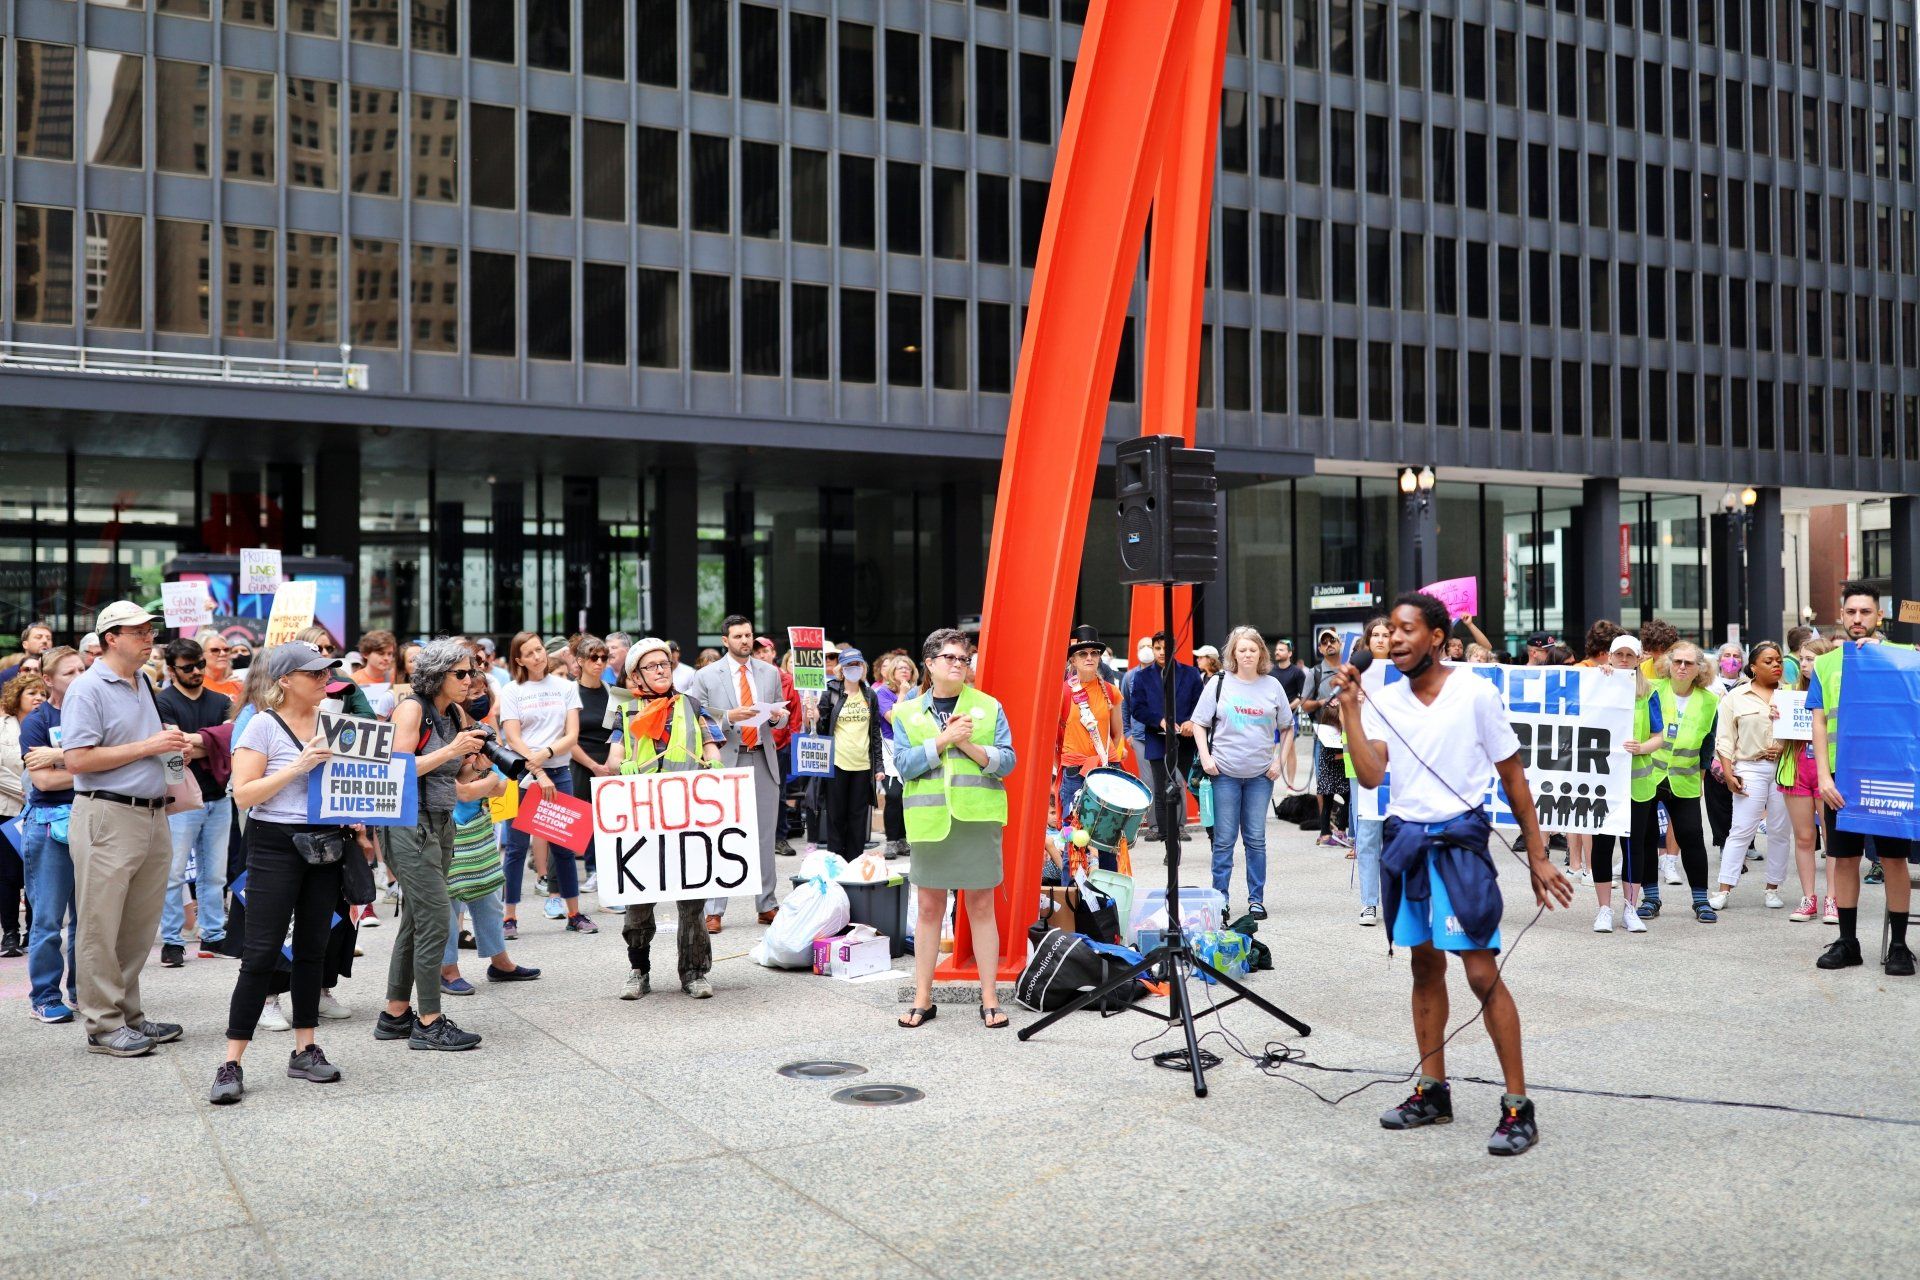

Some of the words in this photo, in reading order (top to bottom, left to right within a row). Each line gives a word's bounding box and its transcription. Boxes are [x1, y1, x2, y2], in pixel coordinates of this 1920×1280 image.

[249, 565, 276, 577] LIVES
[1320, 585, 1345, 595] Jackson
[172, 596, 197, 607] GUN
[273, 615, 308, 623] WITHOUT
[269, 631, 296, 646] LIVE
[791, 629, 822, 644] BLACK
[794, 649, 824, 667] LIVES
[794, 673, 825, 686] MATTER
[1234, 705, 1264, 716] Votes
[321, 714, 392, 759] VOTE
[801, 741, 825, 751] MARCH
[801, 751, 815, 760] FOR
[816, 751, 828, 761] OUR
[330, 762, 389, 779] MARCH
[801, 760, 820, 769] LIVES
[330, 780, 363, 795] FOR
[364, 781, 398, 796] OUR
[330, 796, 375, 812] LIVES
[540, 799, 566, 814] MOMS
[596, 773, 749, 834] GHOST
[1860, 797, 1914, 811] EVERYTOWN
[533, 813, 567, 829] ACTION
[537, 806, 574, 825] DEMAND
[616, 827, 749, 895] KIDS
